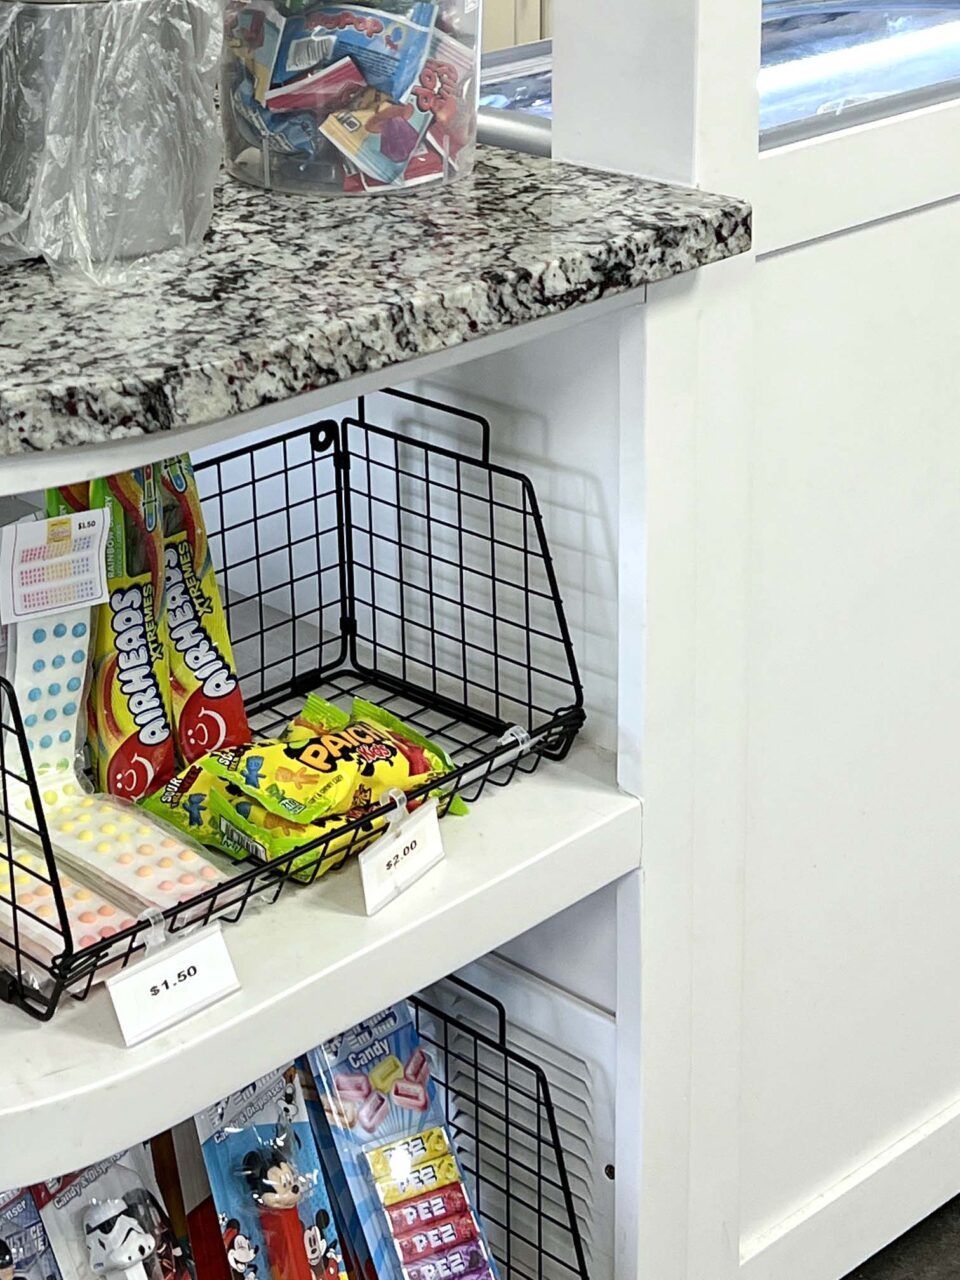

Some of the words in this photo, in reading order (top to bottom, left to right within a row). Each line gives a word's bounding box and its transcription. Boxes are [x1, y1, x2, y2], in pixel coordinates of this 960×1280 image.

[78, 520, 96, 530] $1.50
[180, 541, 213, 617] XTREMES
[142, 583, 163, 662] XTREMES
[165, 547, 237, 697] AIRHEADS
[110, 584, 169, 745] AIRHEADS
[300, 723, 385, 770] PATCH
[161, 777, 183, 805] SOUR
[385, 838, 418, 871] $2.00
[149, 965, 198, 996] $1.50
[348, 1038, 390, 1069] Candy
[398, 1166, 438, 1194] PEZ
[404, 1196, 446, 1226] PEZ
[415, 1223, 457, 1252] PEZ
